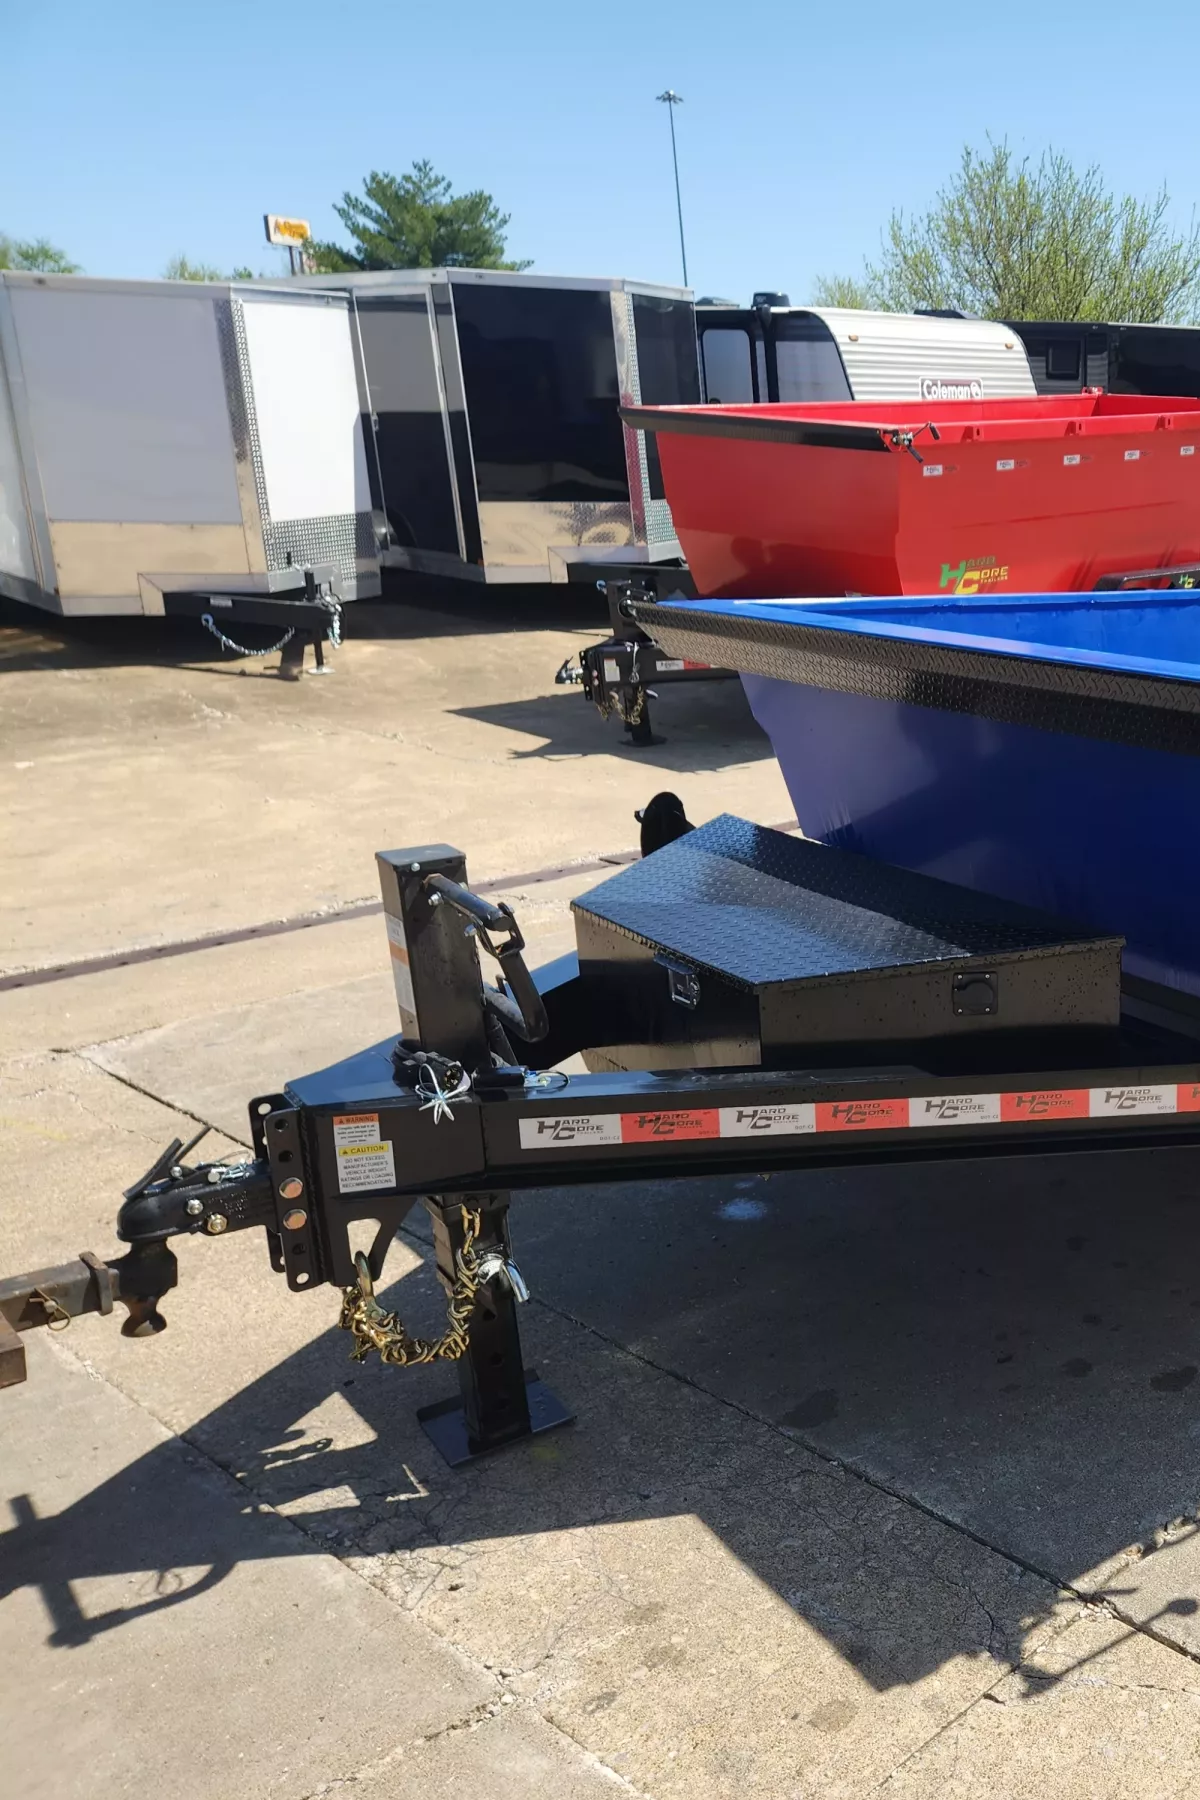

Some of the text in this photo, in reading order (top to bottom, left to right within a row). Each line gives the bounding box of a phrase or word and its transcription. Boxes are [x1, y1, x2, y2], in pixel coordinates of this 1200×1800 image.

[922, 379, 971, 400] Coleman
[954, 566, 1009, 595] CORE
[1015, 1093, 1063, 1108] HARD
[1104, 1088, 1151, 1103] HARD
[1116, 1095, 1163, 1109] CORE
[831, 1103, 881, 1118] HARD
[924, 1098, 973, 1113] HARD
[937, 1104, 985, 1119] CORE
[1029, 1099, 1074, 1114] CORE
[346, 1115, 374, 1124] WARNING
[637, 1113, 690, 1129] HARD
[736, 1107, 787, 1123] HARD
[750, 1114, 799, 1130] CORE
[845, 1109, 893, 1124] CORE
[537, 1118, 591, 1135] HARD
[552, 1124, 604, 1140] CORE
[653, 1119, 703, 1134] CORE
[351, 1145, 384, 1154] CAUTION
